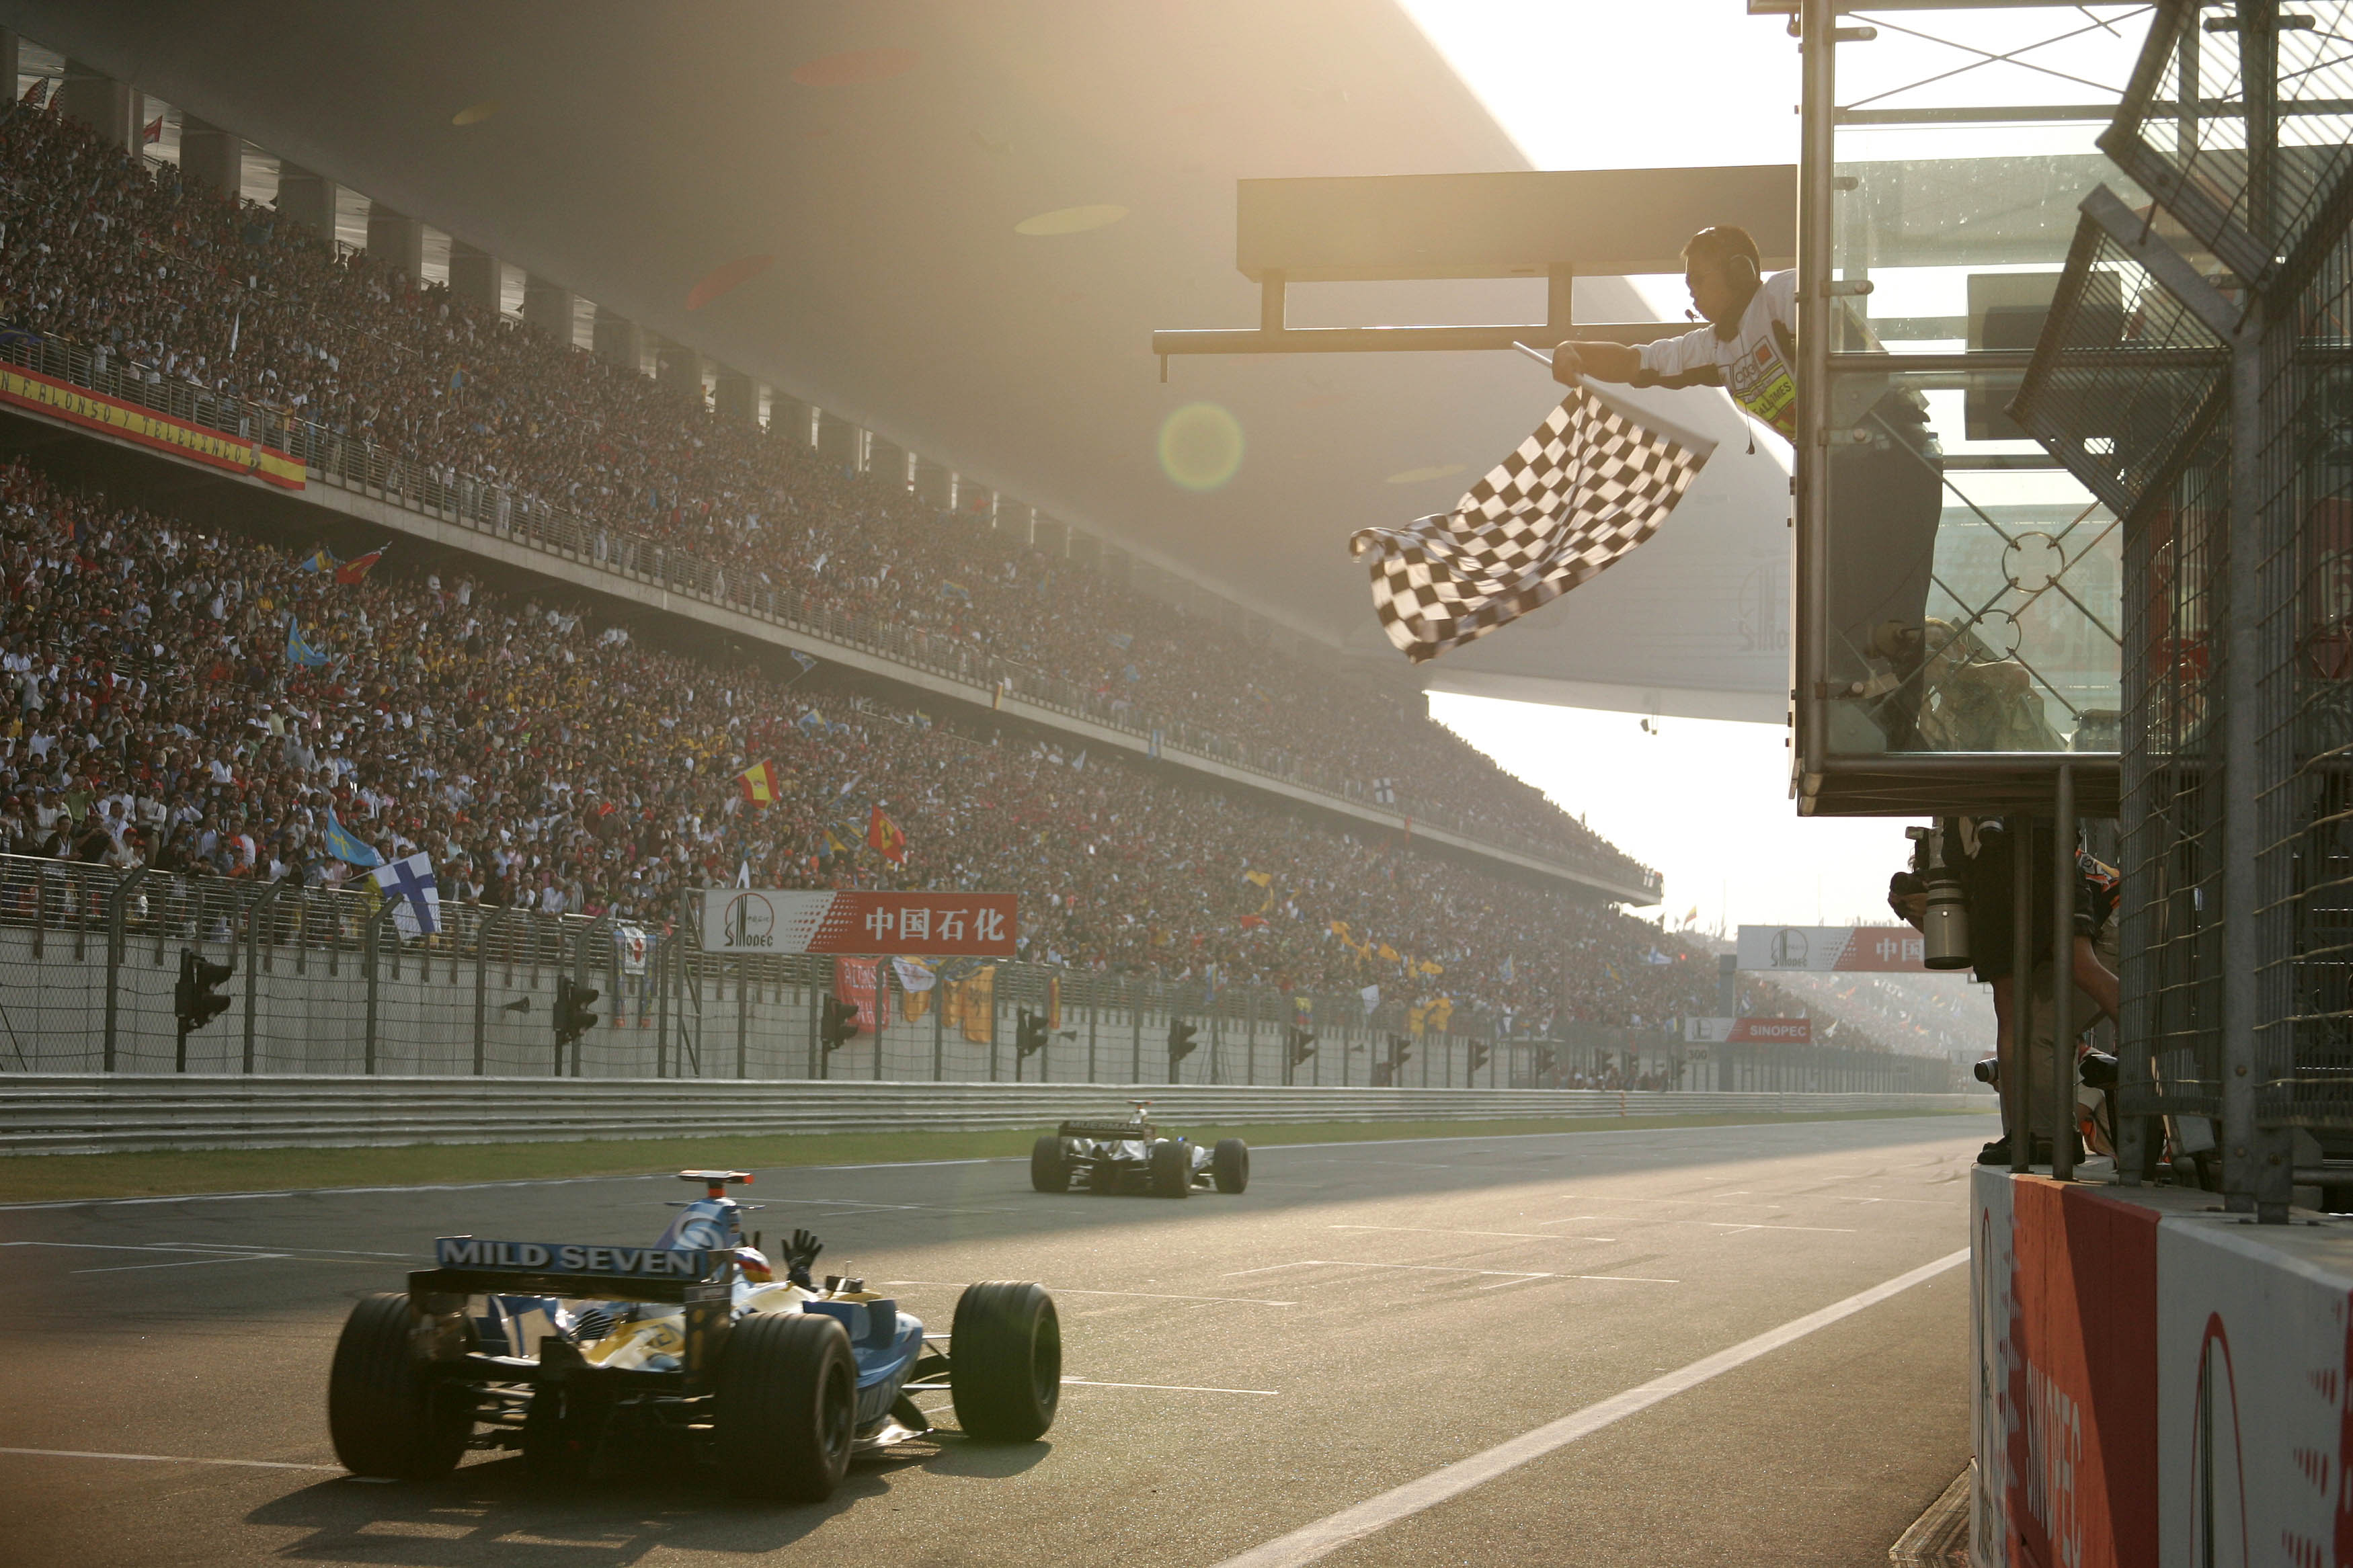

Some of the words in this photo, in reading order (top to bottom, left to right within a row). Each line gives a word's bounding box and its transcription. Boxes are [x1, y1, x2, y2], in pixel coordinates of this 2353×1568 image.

[124, 410, 130, 427] Y
[143, 415, 241, 463] TELECINCO
[865, 907, 1006, 941] 中国石化
[1750, 1026, 1806, 1036] SINOPEC
[1687, 1049, 1708, 1061] 300
[442, 1240, 550, 1267] MILD
[559, 1245, 695, 1275] SEVEN
[2026, 1358, 2081, 1568] SINOPEC
